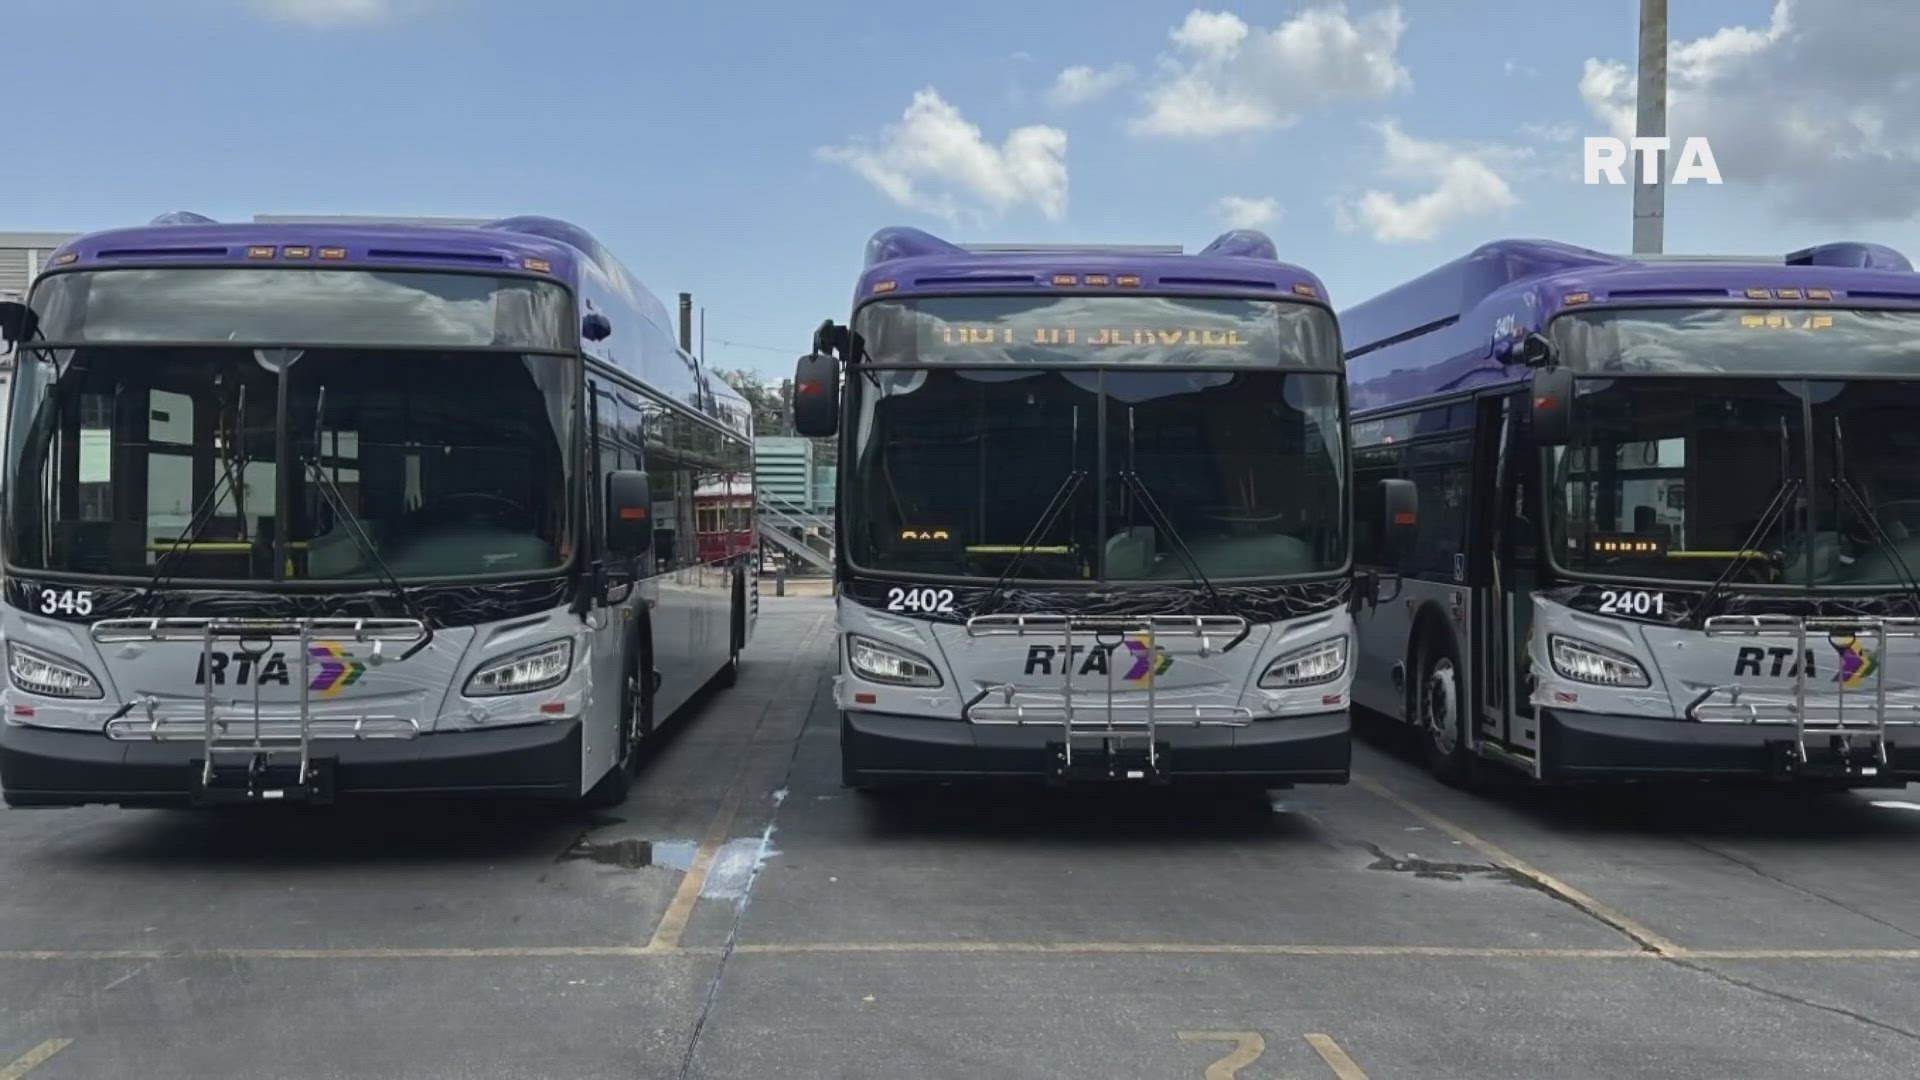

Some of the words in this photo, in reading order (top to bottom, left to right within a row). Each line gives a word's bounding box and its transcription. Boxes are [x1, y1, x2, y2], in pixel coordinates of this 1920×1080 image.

[40, 589, 93, 615] 345
[887, 588, 954, 612] 2402
[1600, 591, 1665, 615] 2401
[195, 651, 290, 686] RTA
[1024, 644, 1112, 676] RTA
[1734, 647, 1816, 678] RTA
